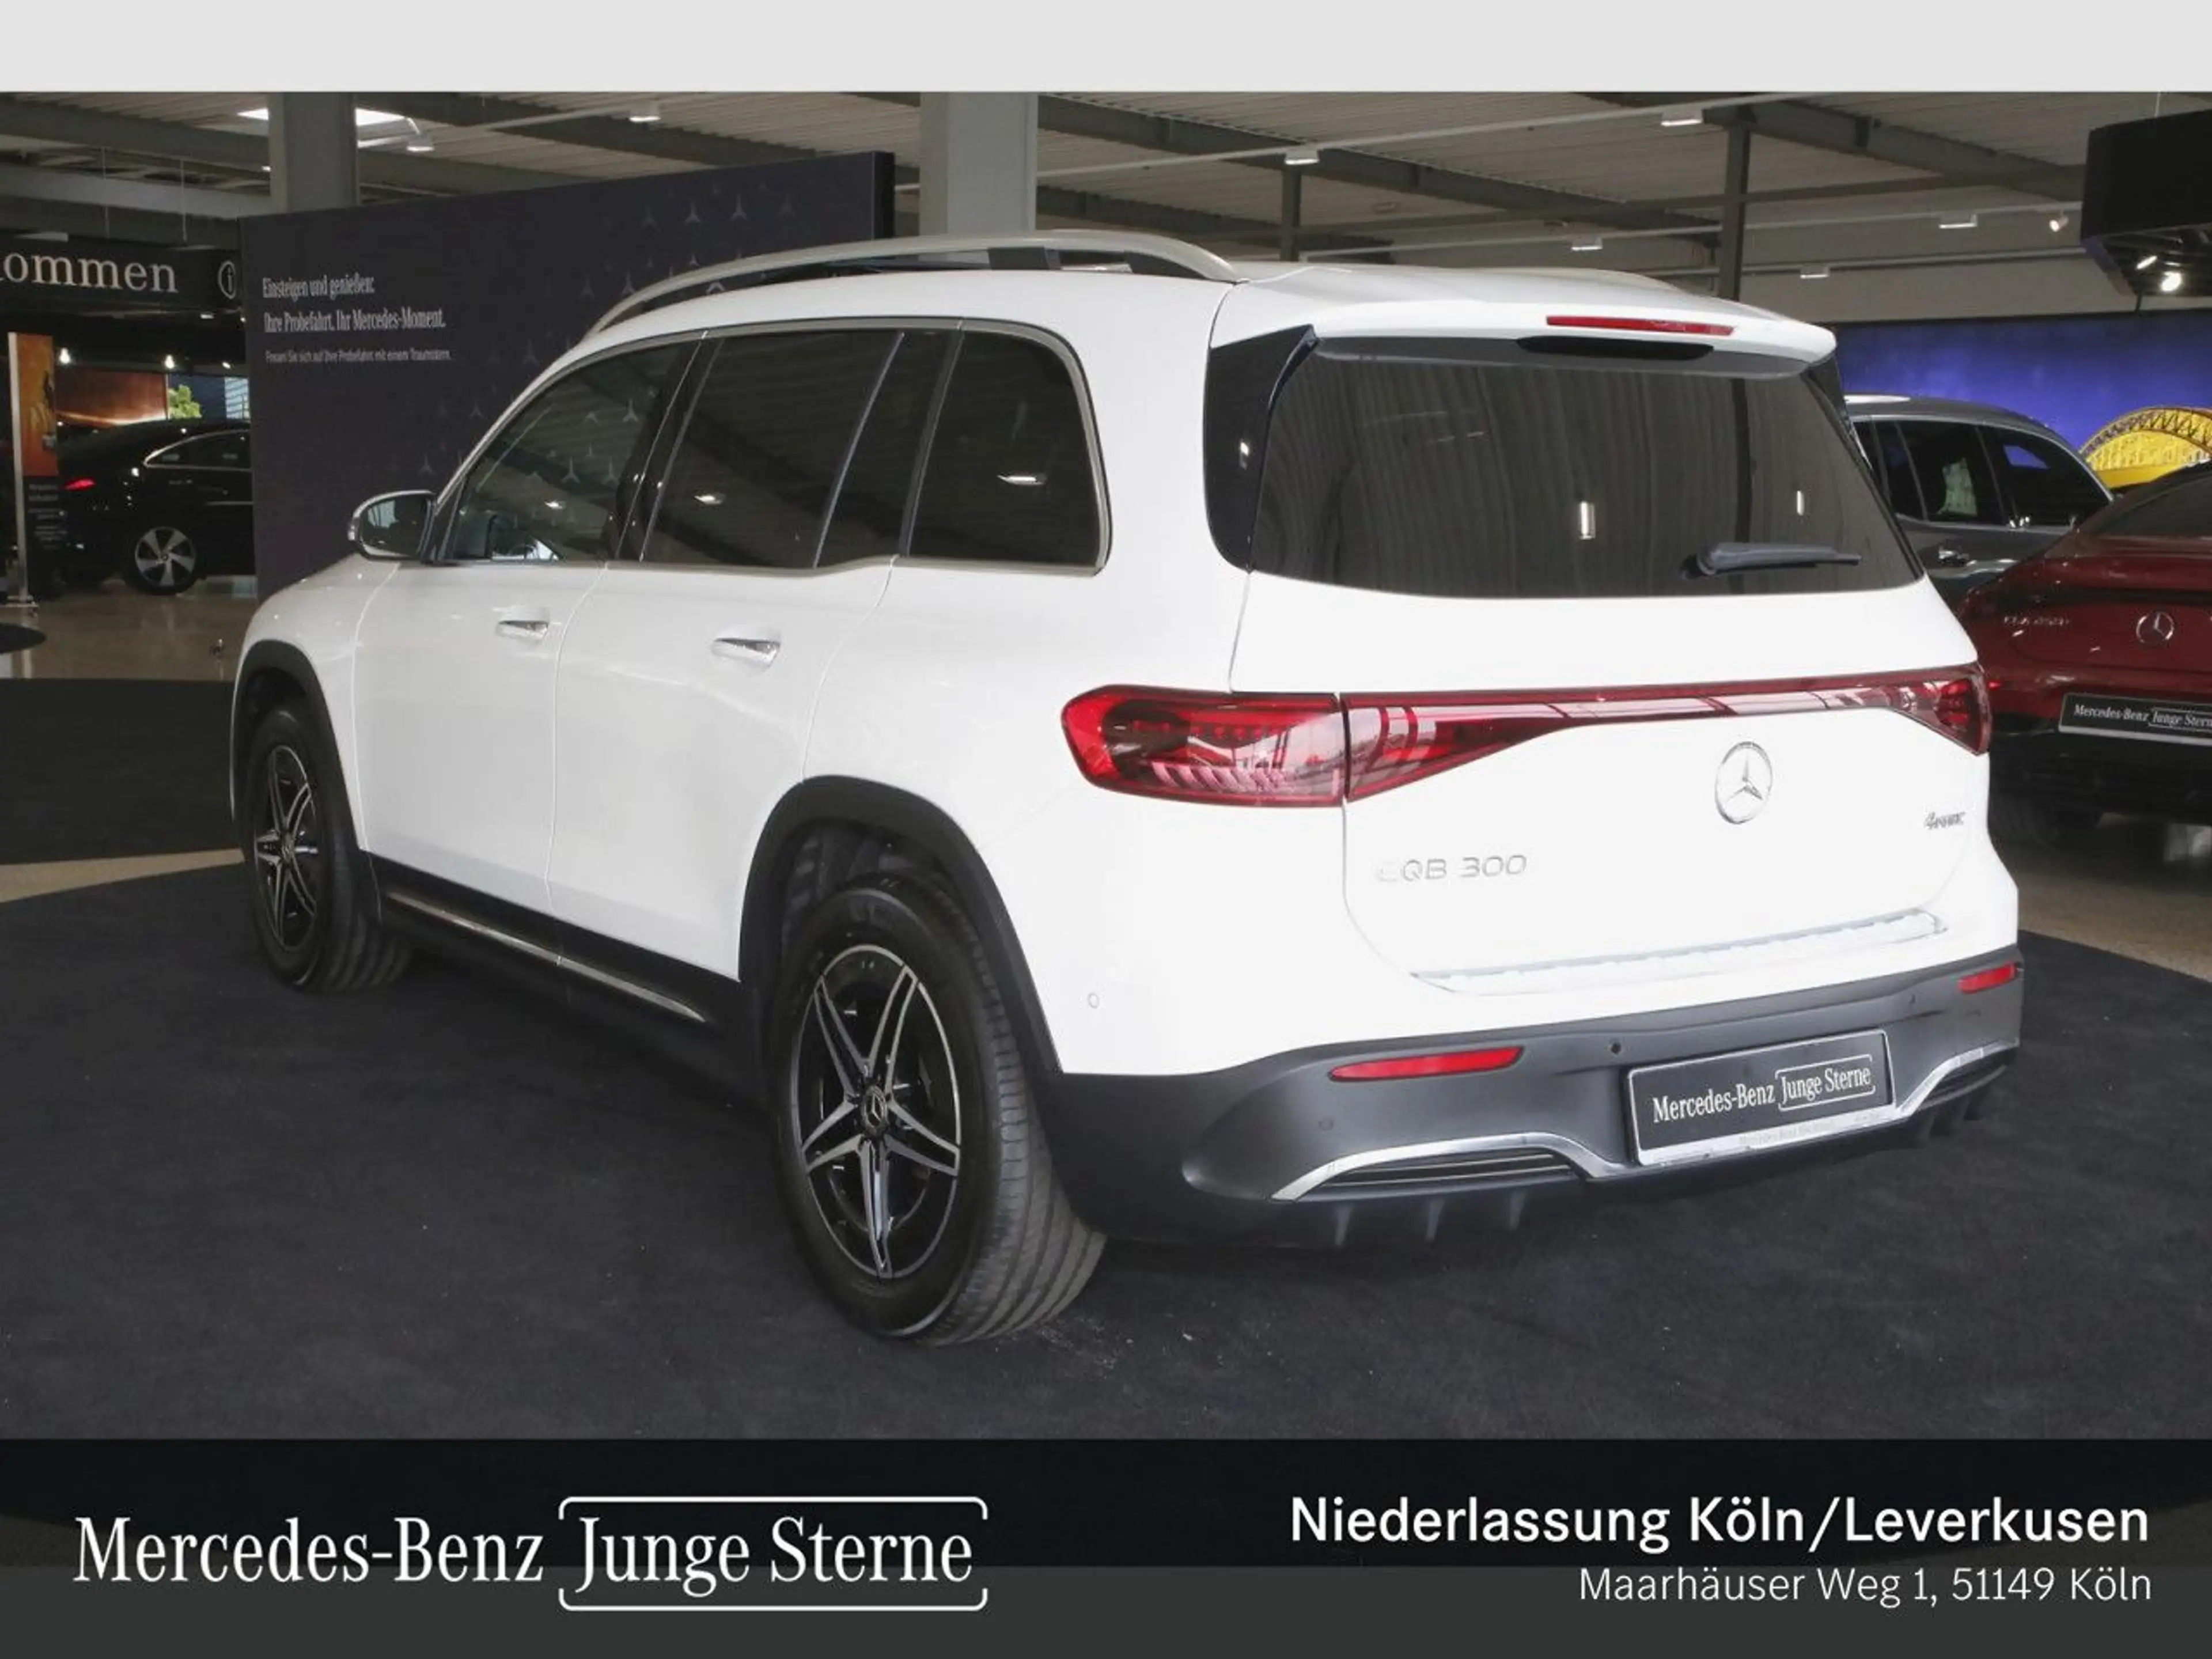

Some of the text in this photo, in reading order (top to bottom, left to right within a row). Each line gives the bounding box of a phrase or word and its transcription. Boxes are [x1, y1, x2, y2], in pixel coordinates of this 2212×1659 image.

[0, 252, 178, 293] ommen
[309, 274, 327, 297] und
[2074, 703, 2149, 722] Mercedes-Benz
[1459, 854, 1528, 878] 300
[1652, 1065, 1872, 1123] Mercedes-Benz Junge Sterne
